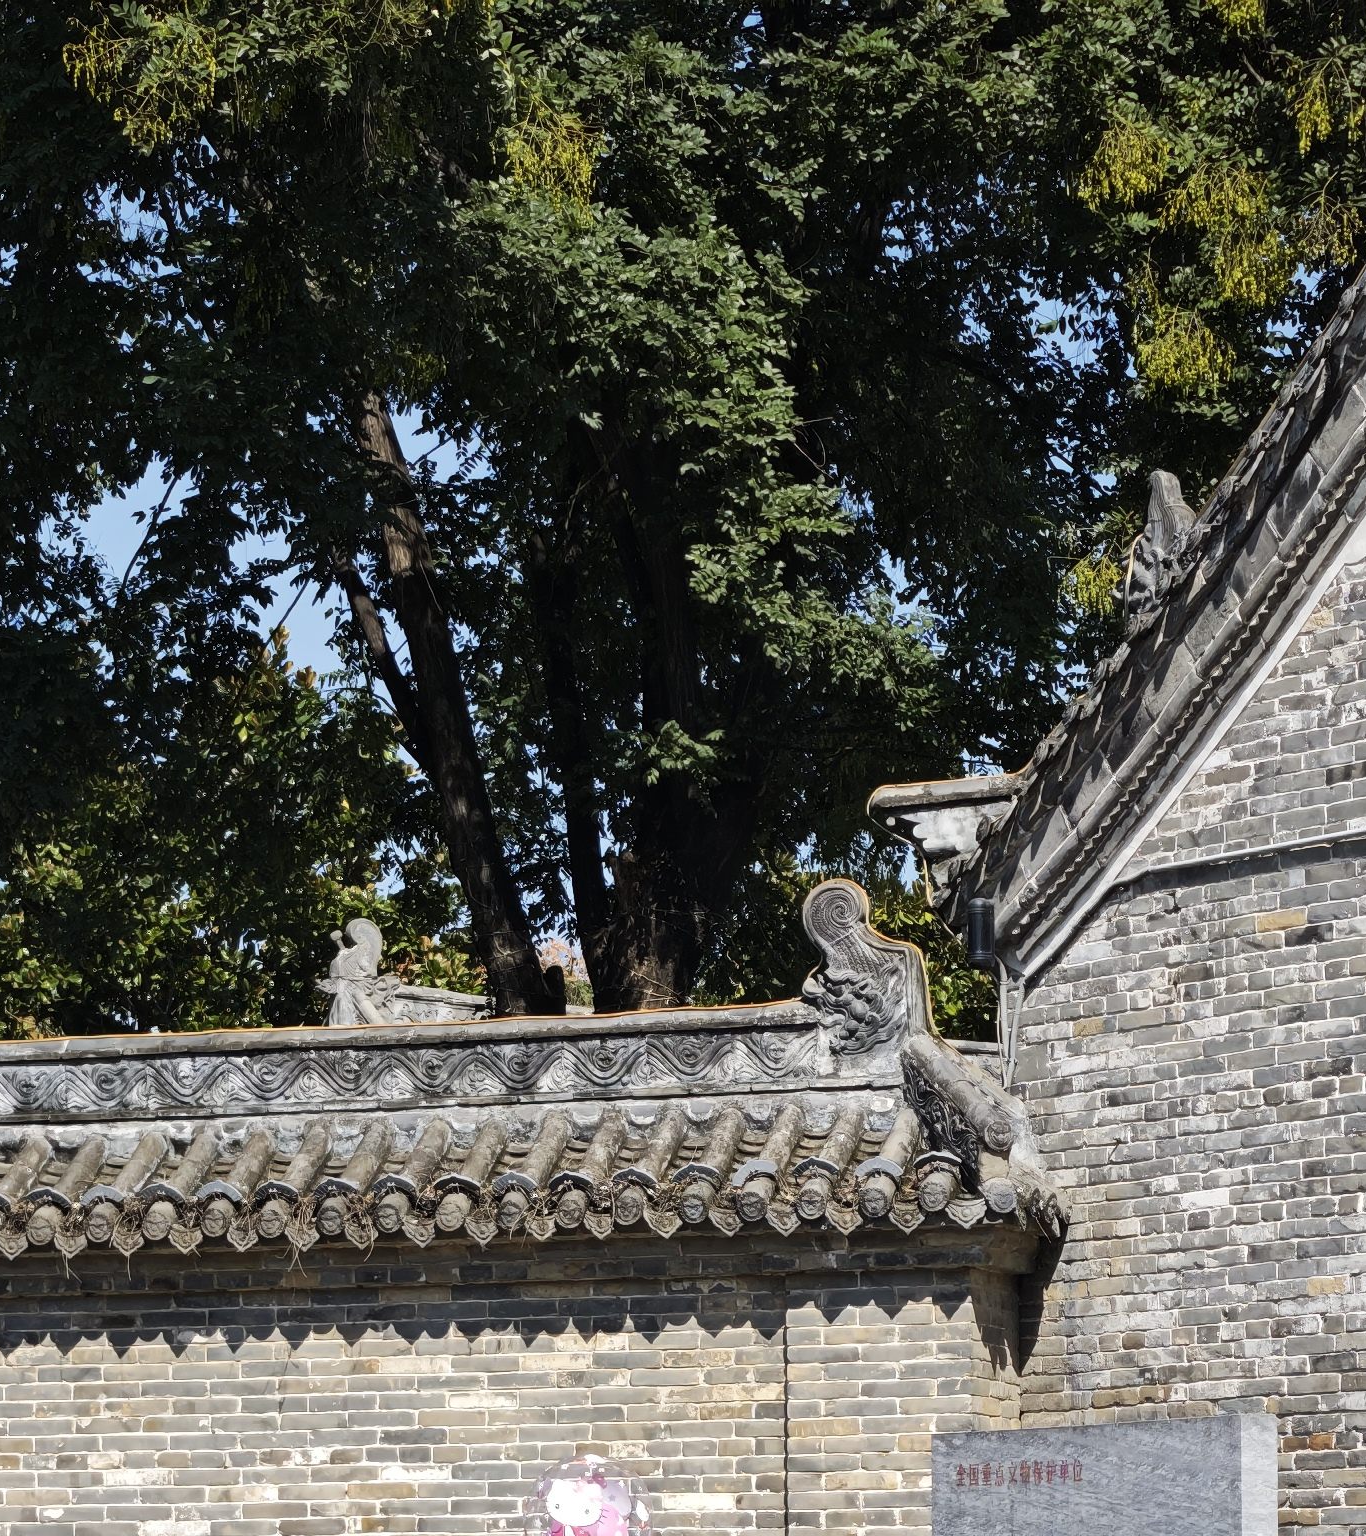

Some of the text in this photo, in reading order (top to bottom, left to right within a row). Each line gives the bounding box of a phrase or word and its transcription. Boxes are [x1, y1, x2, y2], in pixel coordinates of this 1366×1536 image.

[955, 1459, 1083, 1486] 全国重点文物保护单位
